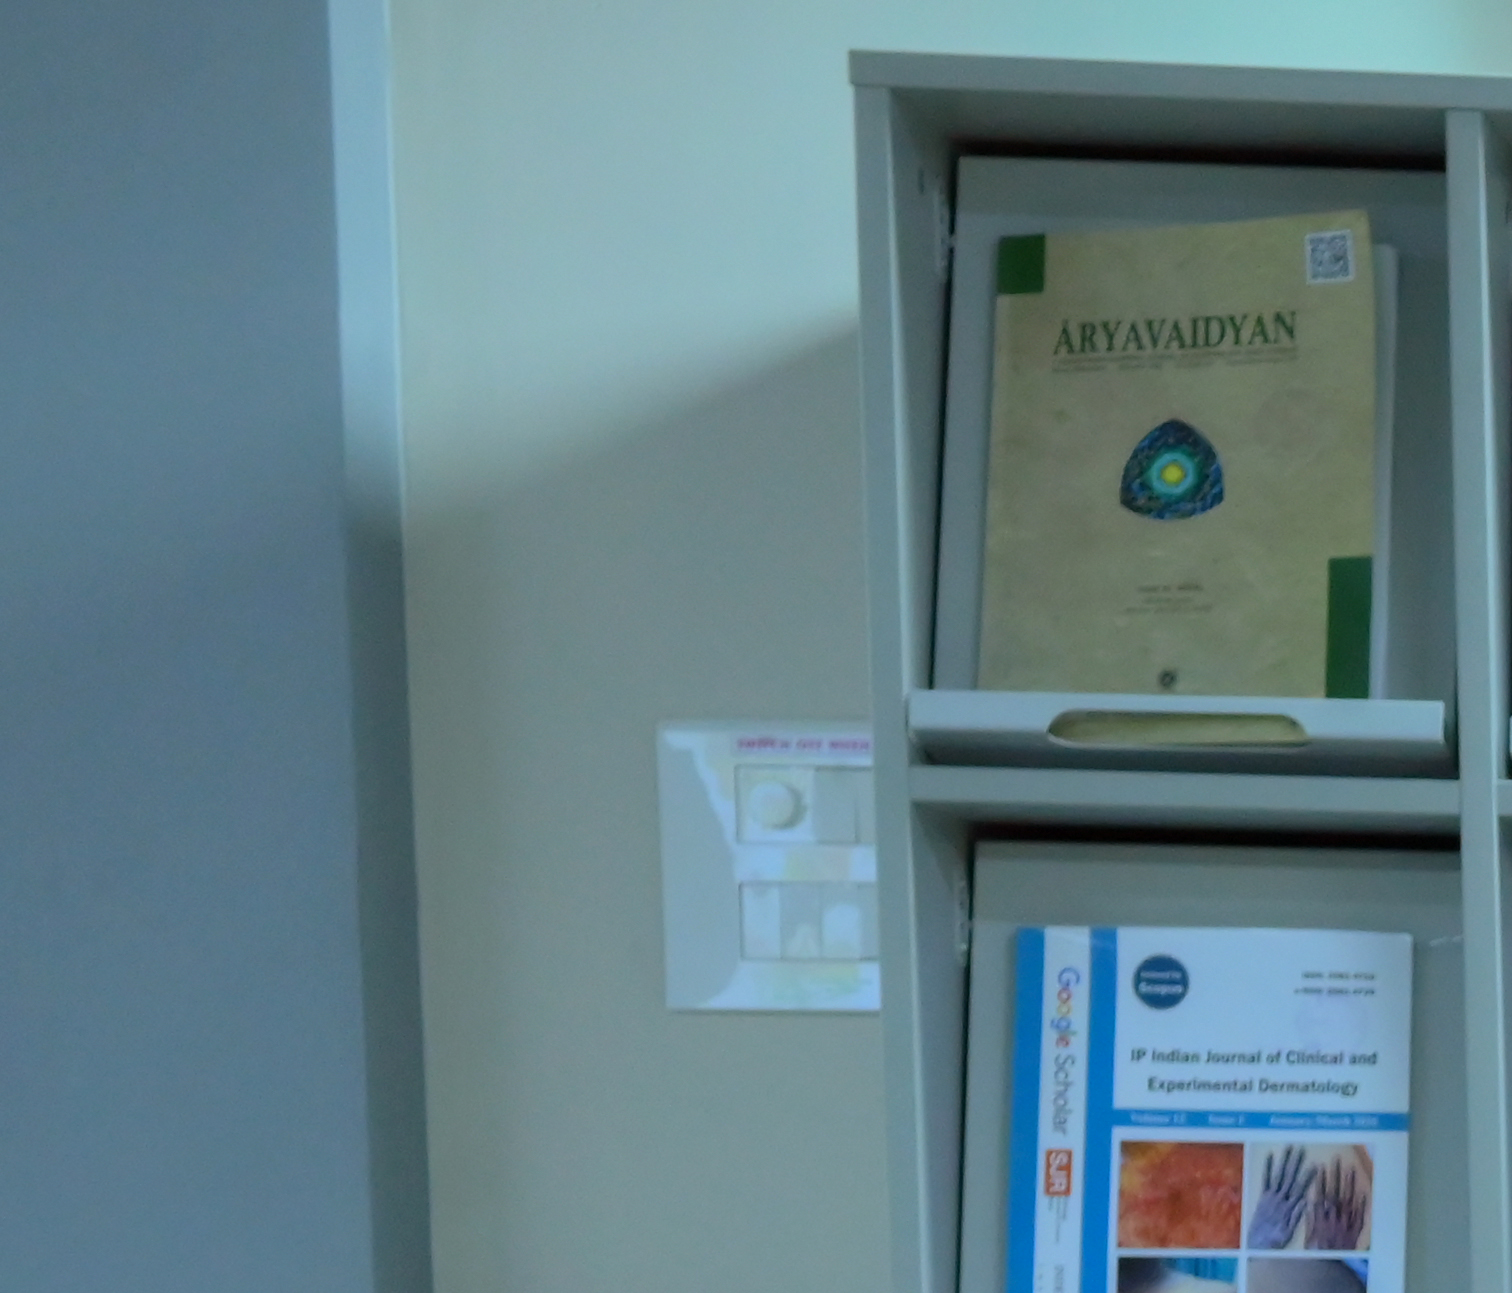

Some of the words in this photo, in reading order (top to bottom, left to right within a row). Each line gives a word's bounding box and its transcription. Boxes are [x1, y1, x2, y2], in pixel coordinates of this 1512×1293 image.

[1053, 310, 1297, 356] ARYAVAIDYAN
[1050, 967, 1081, 1049] Google
[1130, 1049, 1146, 1063] IP
[1151, 1049, 1199, 1064] Indian
[1205, 1049, 1260, 1065] Journal
[1265, 1049, 1281, 1065] of
[1285, 1050, 1343, 1065] Clinical
[1348, 1051, 1378, 1066] and
[1050, 1053, 1076, 1136] Scholar
[1147, 1077, 1252, 1095] Experimental
[1258, 1077, 1358, 1097] Dermatology
